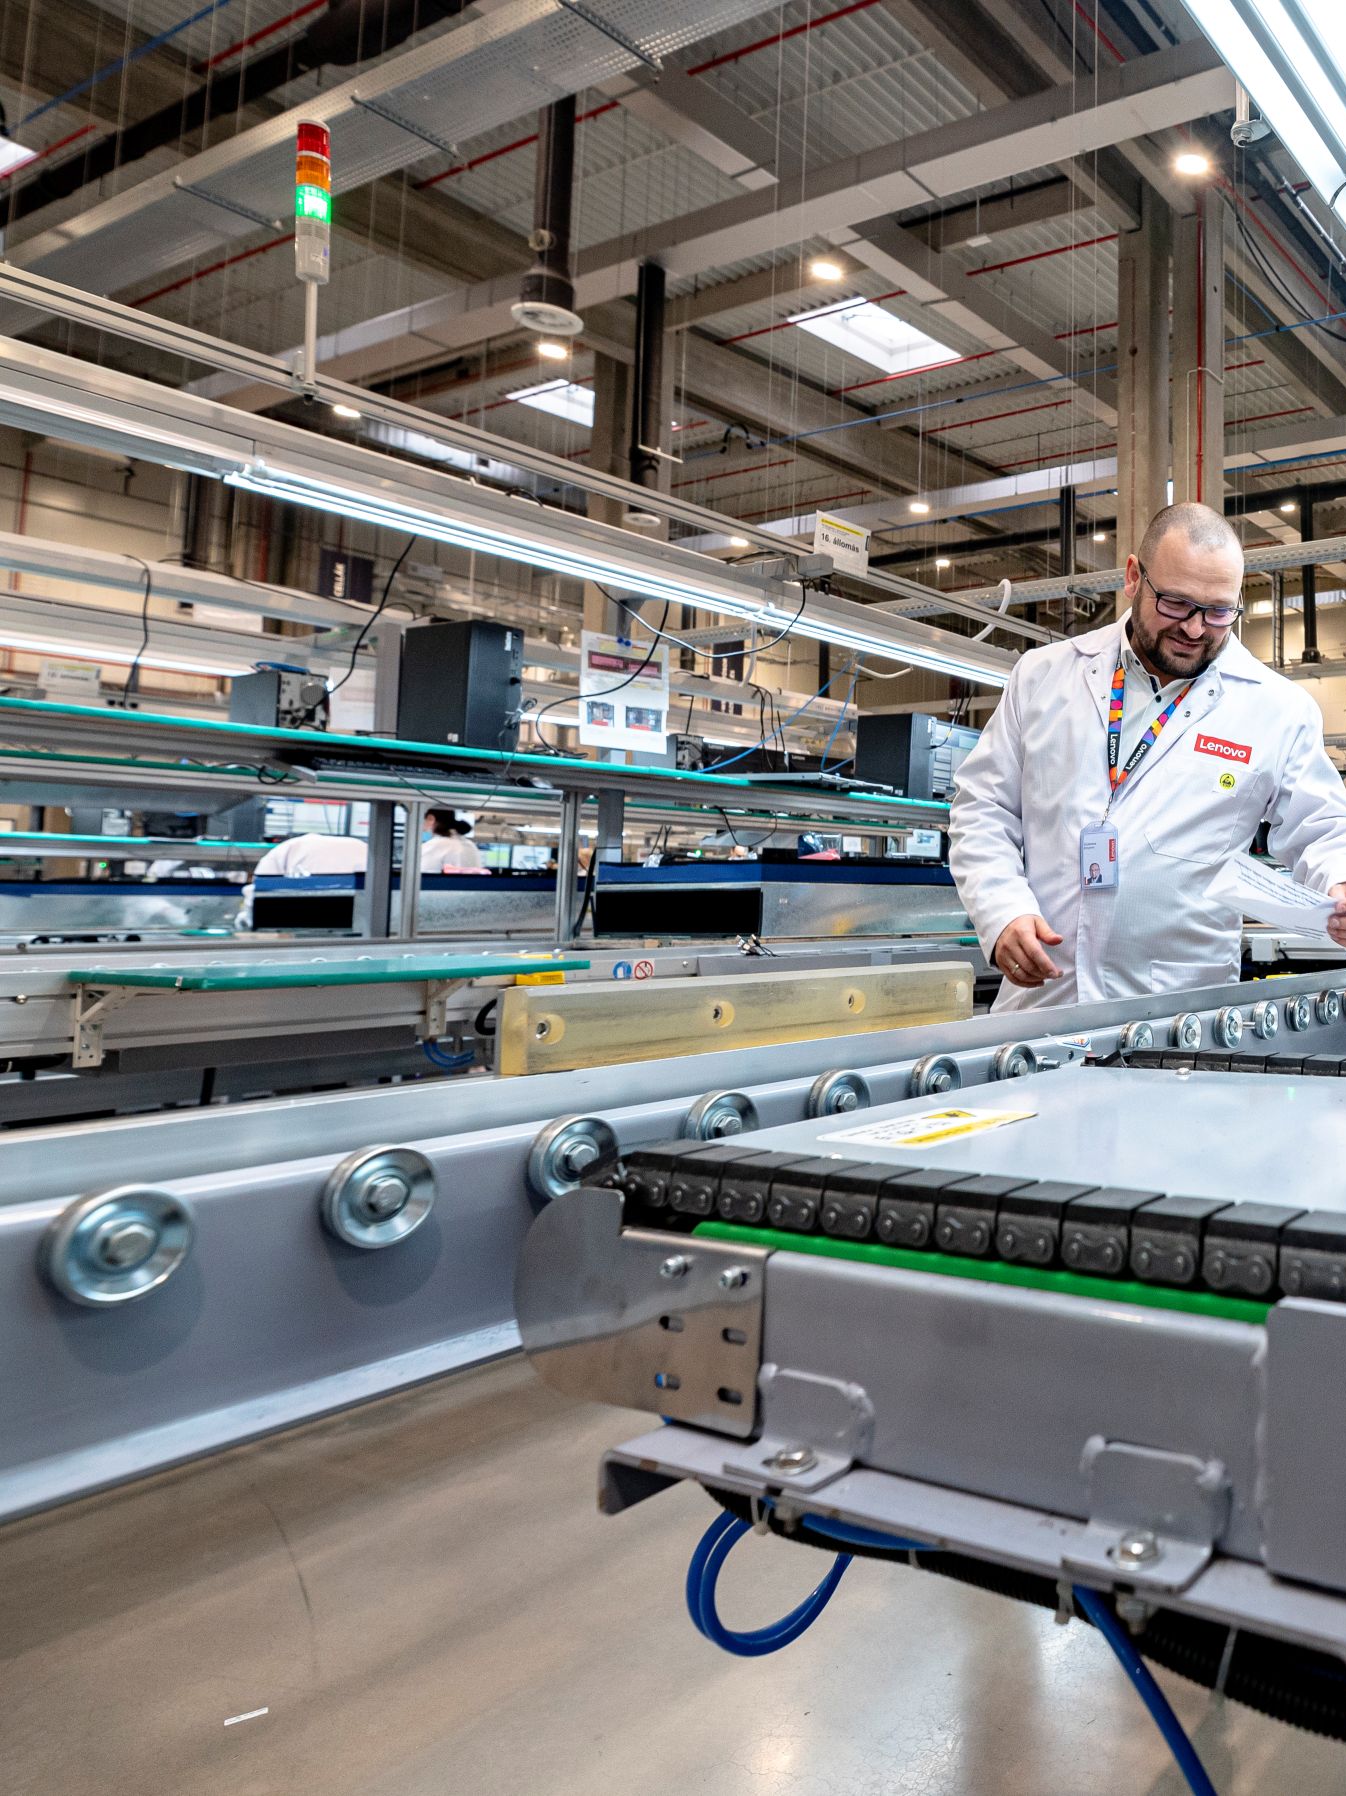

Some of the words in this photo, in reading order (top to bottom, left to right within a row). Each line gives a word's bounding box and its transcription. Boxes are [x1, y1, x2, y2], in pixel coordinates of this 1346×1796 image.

[821, 533, 831, 543] 16.
[832, 537, 860, 553] állomás
[1110, 733, 1119, 765] Lenovo
[1125, 743, 1148, 770] Lenovo
[1199, 738, 1247, 758] Lenovo
